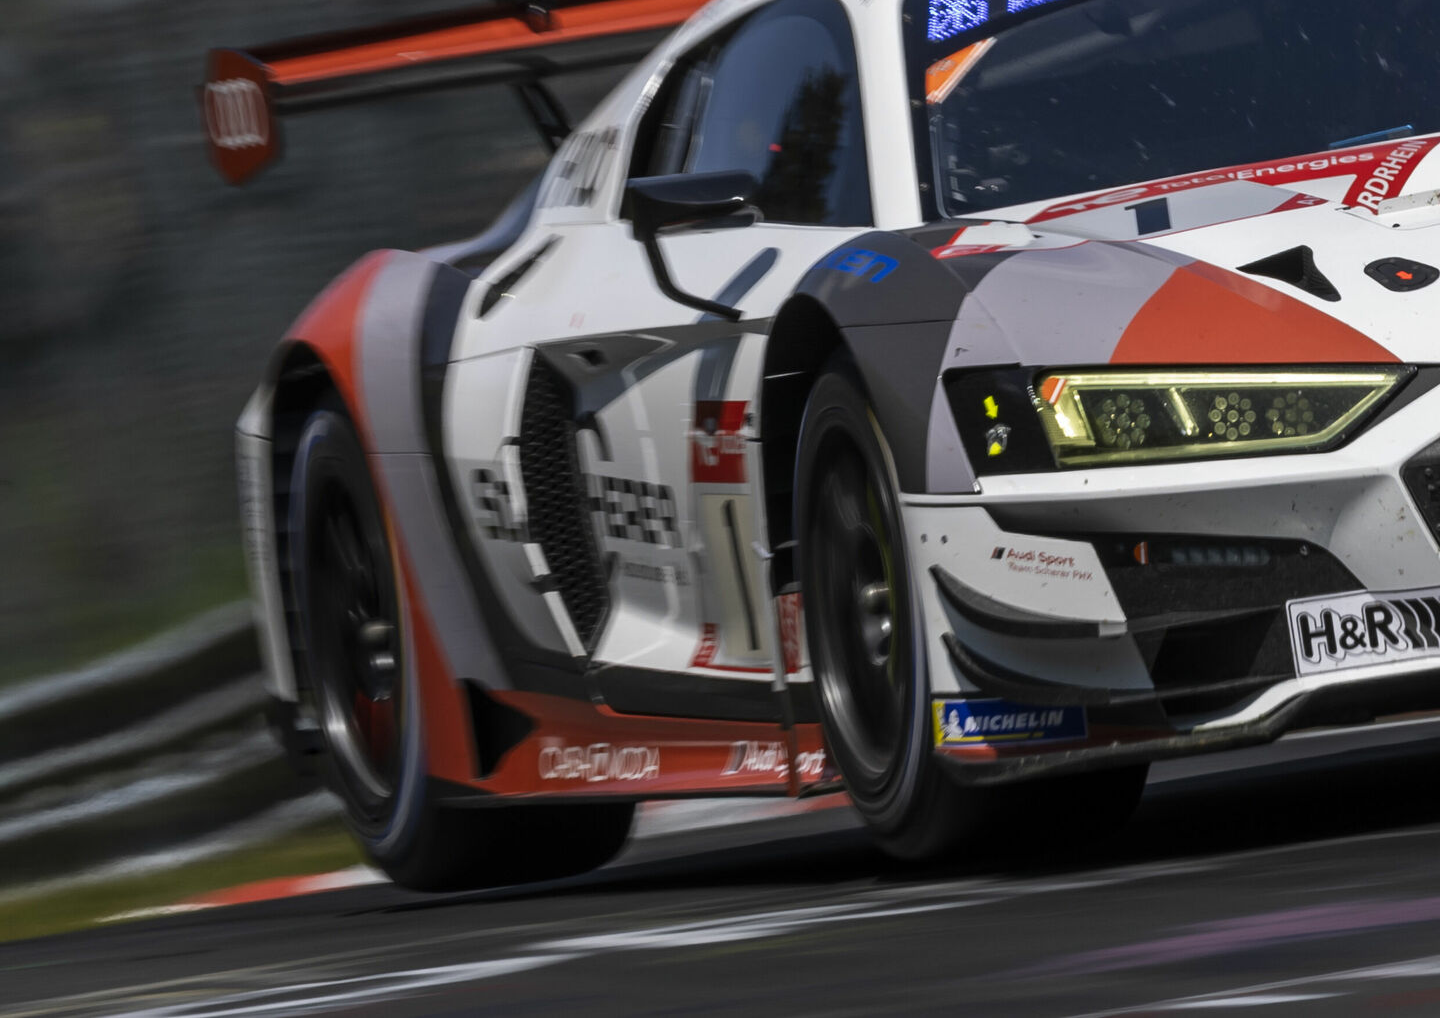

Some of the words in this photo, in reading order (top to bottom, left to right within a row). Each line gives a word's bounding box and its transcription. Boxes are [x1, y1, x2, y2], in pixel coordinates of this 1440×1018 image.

[1355, 140, 1428, 212] RDRHEIN
[1007, 548, 1036, 561] Audi
[1038, 552, 1075, 567] Sport
[1297, 601, 1405, 662] H&R
[963, 709, 1065, 732] MICHELIN
